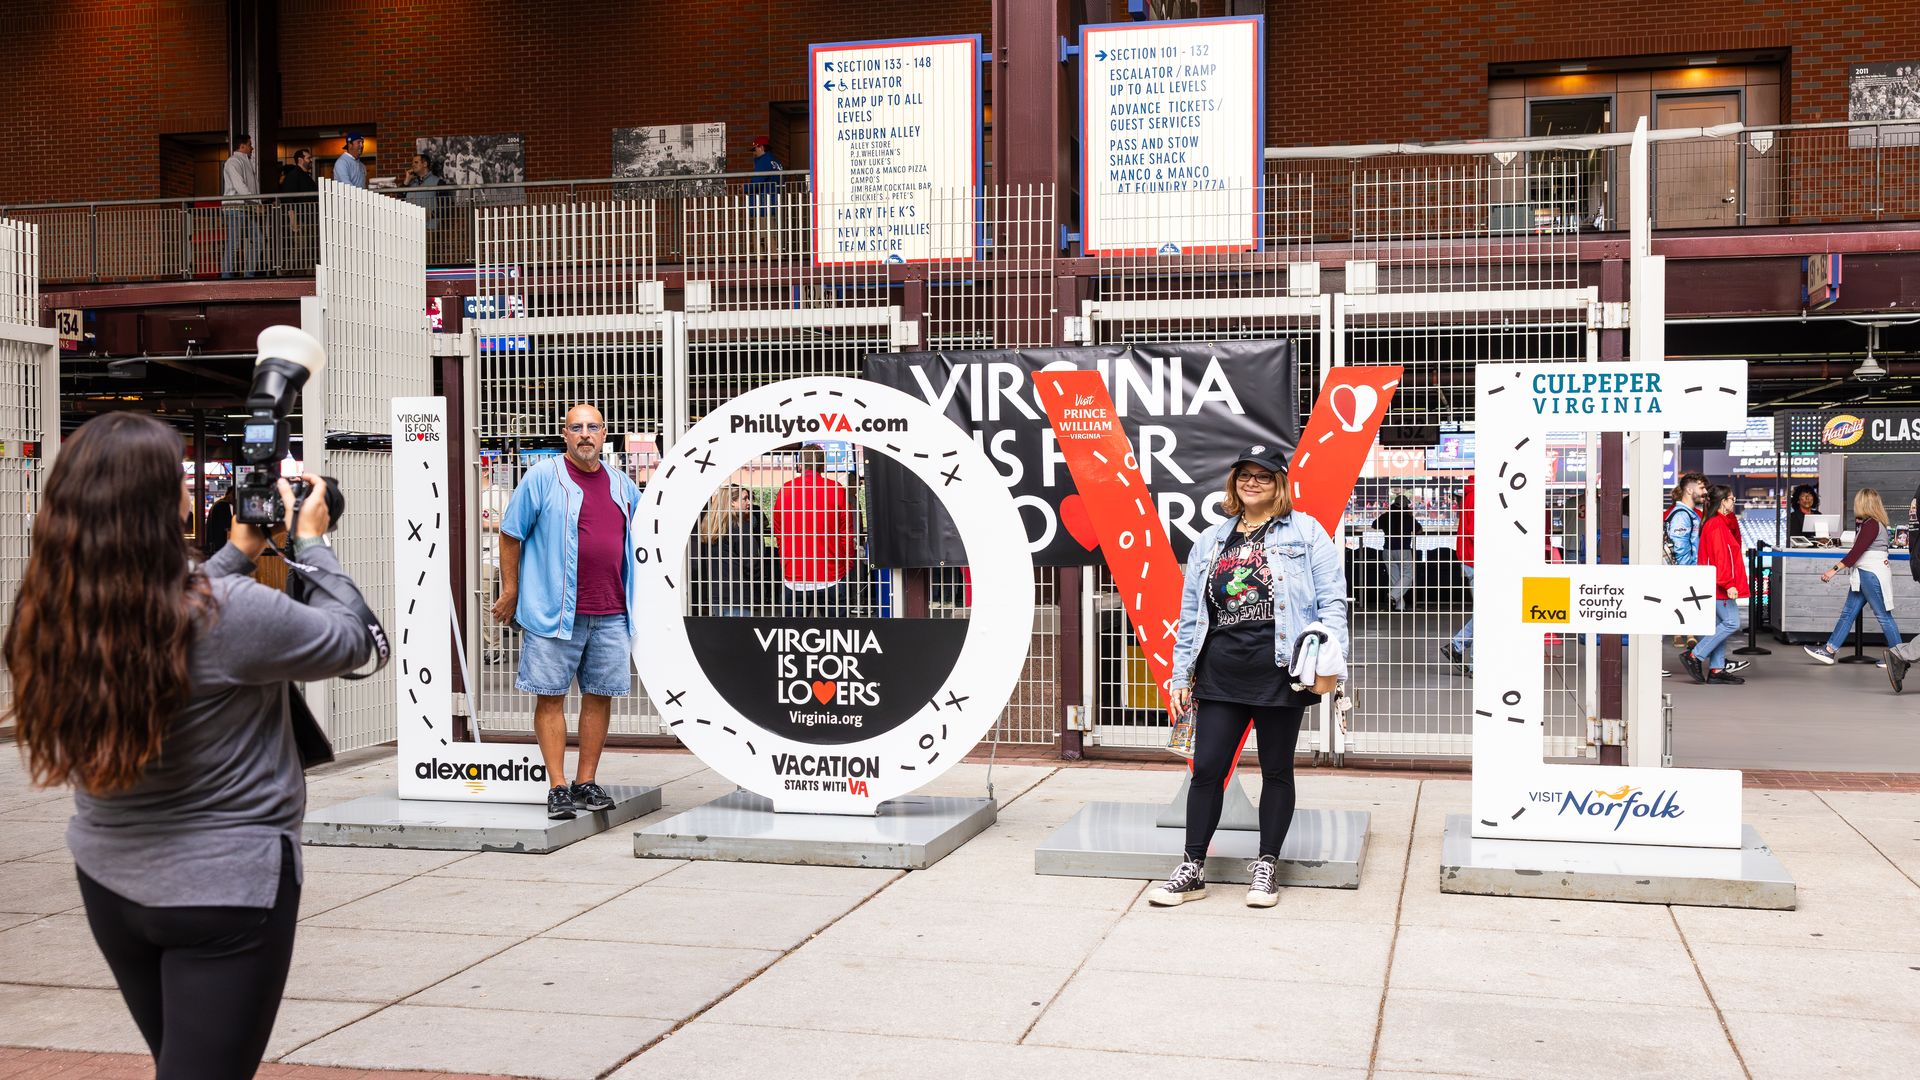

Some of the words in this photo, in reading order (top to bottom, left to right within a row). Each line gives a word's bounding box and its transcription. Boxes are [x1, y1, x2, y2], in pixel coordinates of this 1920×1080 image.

[1110, 47, 1156, 61] SECTION
[1161, 47, 1177, 59] 101
[1191, 45, 1209, 56] 132
[837, 59, 881, 72] SECTION
[885, 58, 902, 70] 133
[914, 56, 932, 68] 148
[1110, 66, 1173, 81] ESCALATOR
[1185, 64, 1217, 77] RAMP
[852, 76, 902, 90] ELEVATOR
[1110, 84, 1124, 96] UP
[1128, 83, 1141, 95] TO
[1146, 82, 1165, 94] ALL
[1169, 80, 1207, 93] LEVELS
[837, 96, 867, 109] RAMP
[871, 95, 884, 107] UP
[888, 94, 901, 106] TO
[905, 93, 923, 105] ALL
[837, 110, 872, 123] LEVELS
[1110, 102, 1161, 116] ADVANCE
[1110, 118, 1144, 131] GUEST
[1149, 116, 1201, 130] SERVICES
[837, 127, 887, 141] ASHBURN
[890, 125, 921, 139] ALLEY
[850, 142, 869, 150] ALLEY
[871, 141, 891, 149] STORE
[1110, 139, 1137, 151] PASS
[1141, 138, 1164, 150] AND
[1168, 136, 1199, 149] STOW
[850, 159, 866, 167] TONY
[869, 158, 891, 166] LUKE'S
[1110, 153, 1145, 166] SHAKE
[1149, 152, 1186, 165] SHACK
[850, 167, 874, 176] MANCO
[876, 167, 881, 175] &
[882, 166, 906, 174] MANCO
[908, 164, 927, 173] PIZZA
[1110, 168, 1151, 181] MANCO
[1155, 167, 1163, 180] &
[1168, 166, 1209, 179] MANCO
[850, 176, 880, 184] CAMPO'S
[850, 185, 862, 193] JIM
[864, 184, 884, 192] BEAM
[884, 183, 916, 191] COCKTAIL
[918, 182, 932, 190] BAR
[1118, 182, 1131, 193] AT
[892, 191, 914, 200] PETE'S
[899, 205, 915, 217] K'S
[57, 312, 79, 336] 134
[1532, 373, 1662, 394] CULPEPER
[1074, 393, 1095, 407] Visit
[1532, 397, 1662, 414] VIRGINIA
[397, 413, 441, 423] VIRGINIA
[1063, 408, 1107, 419] PRINCE
[405, 423, 413, 432] IS
[414, 423, 434, 432] FOR
[730, 413, 908, 438] PhillytoVA.com
[1058, 421, 1113, 431] WILLIAM
[1821, 417, 1865, 443] Hatfield
[1042, 425, 1195, 487] FR
[1578, 584, 1625, 596] fairfax
[1578, 597, 1623, 610] county
[1530, 605, 1567, 620] fxva
[1578, 608, 1627, 621] virginia
[753, 628, 883, 654] VIRGINIA
[778, 654, 798, 679] IS
[806, 654, 864, 680] FOR
[789, 711, 863, 727] Virginia.org
[415, 756, 547, 782] alexandria
[771, 753, 880, 779] VACATION
[784, 779, 819, 792] STARTS
[822, 780, 847, 793] WITH
[848, 778, 869, 798] VA
[1528, 791, 1563, 803] VISIT
[1558, 789, 1685, 831] Norfolk
